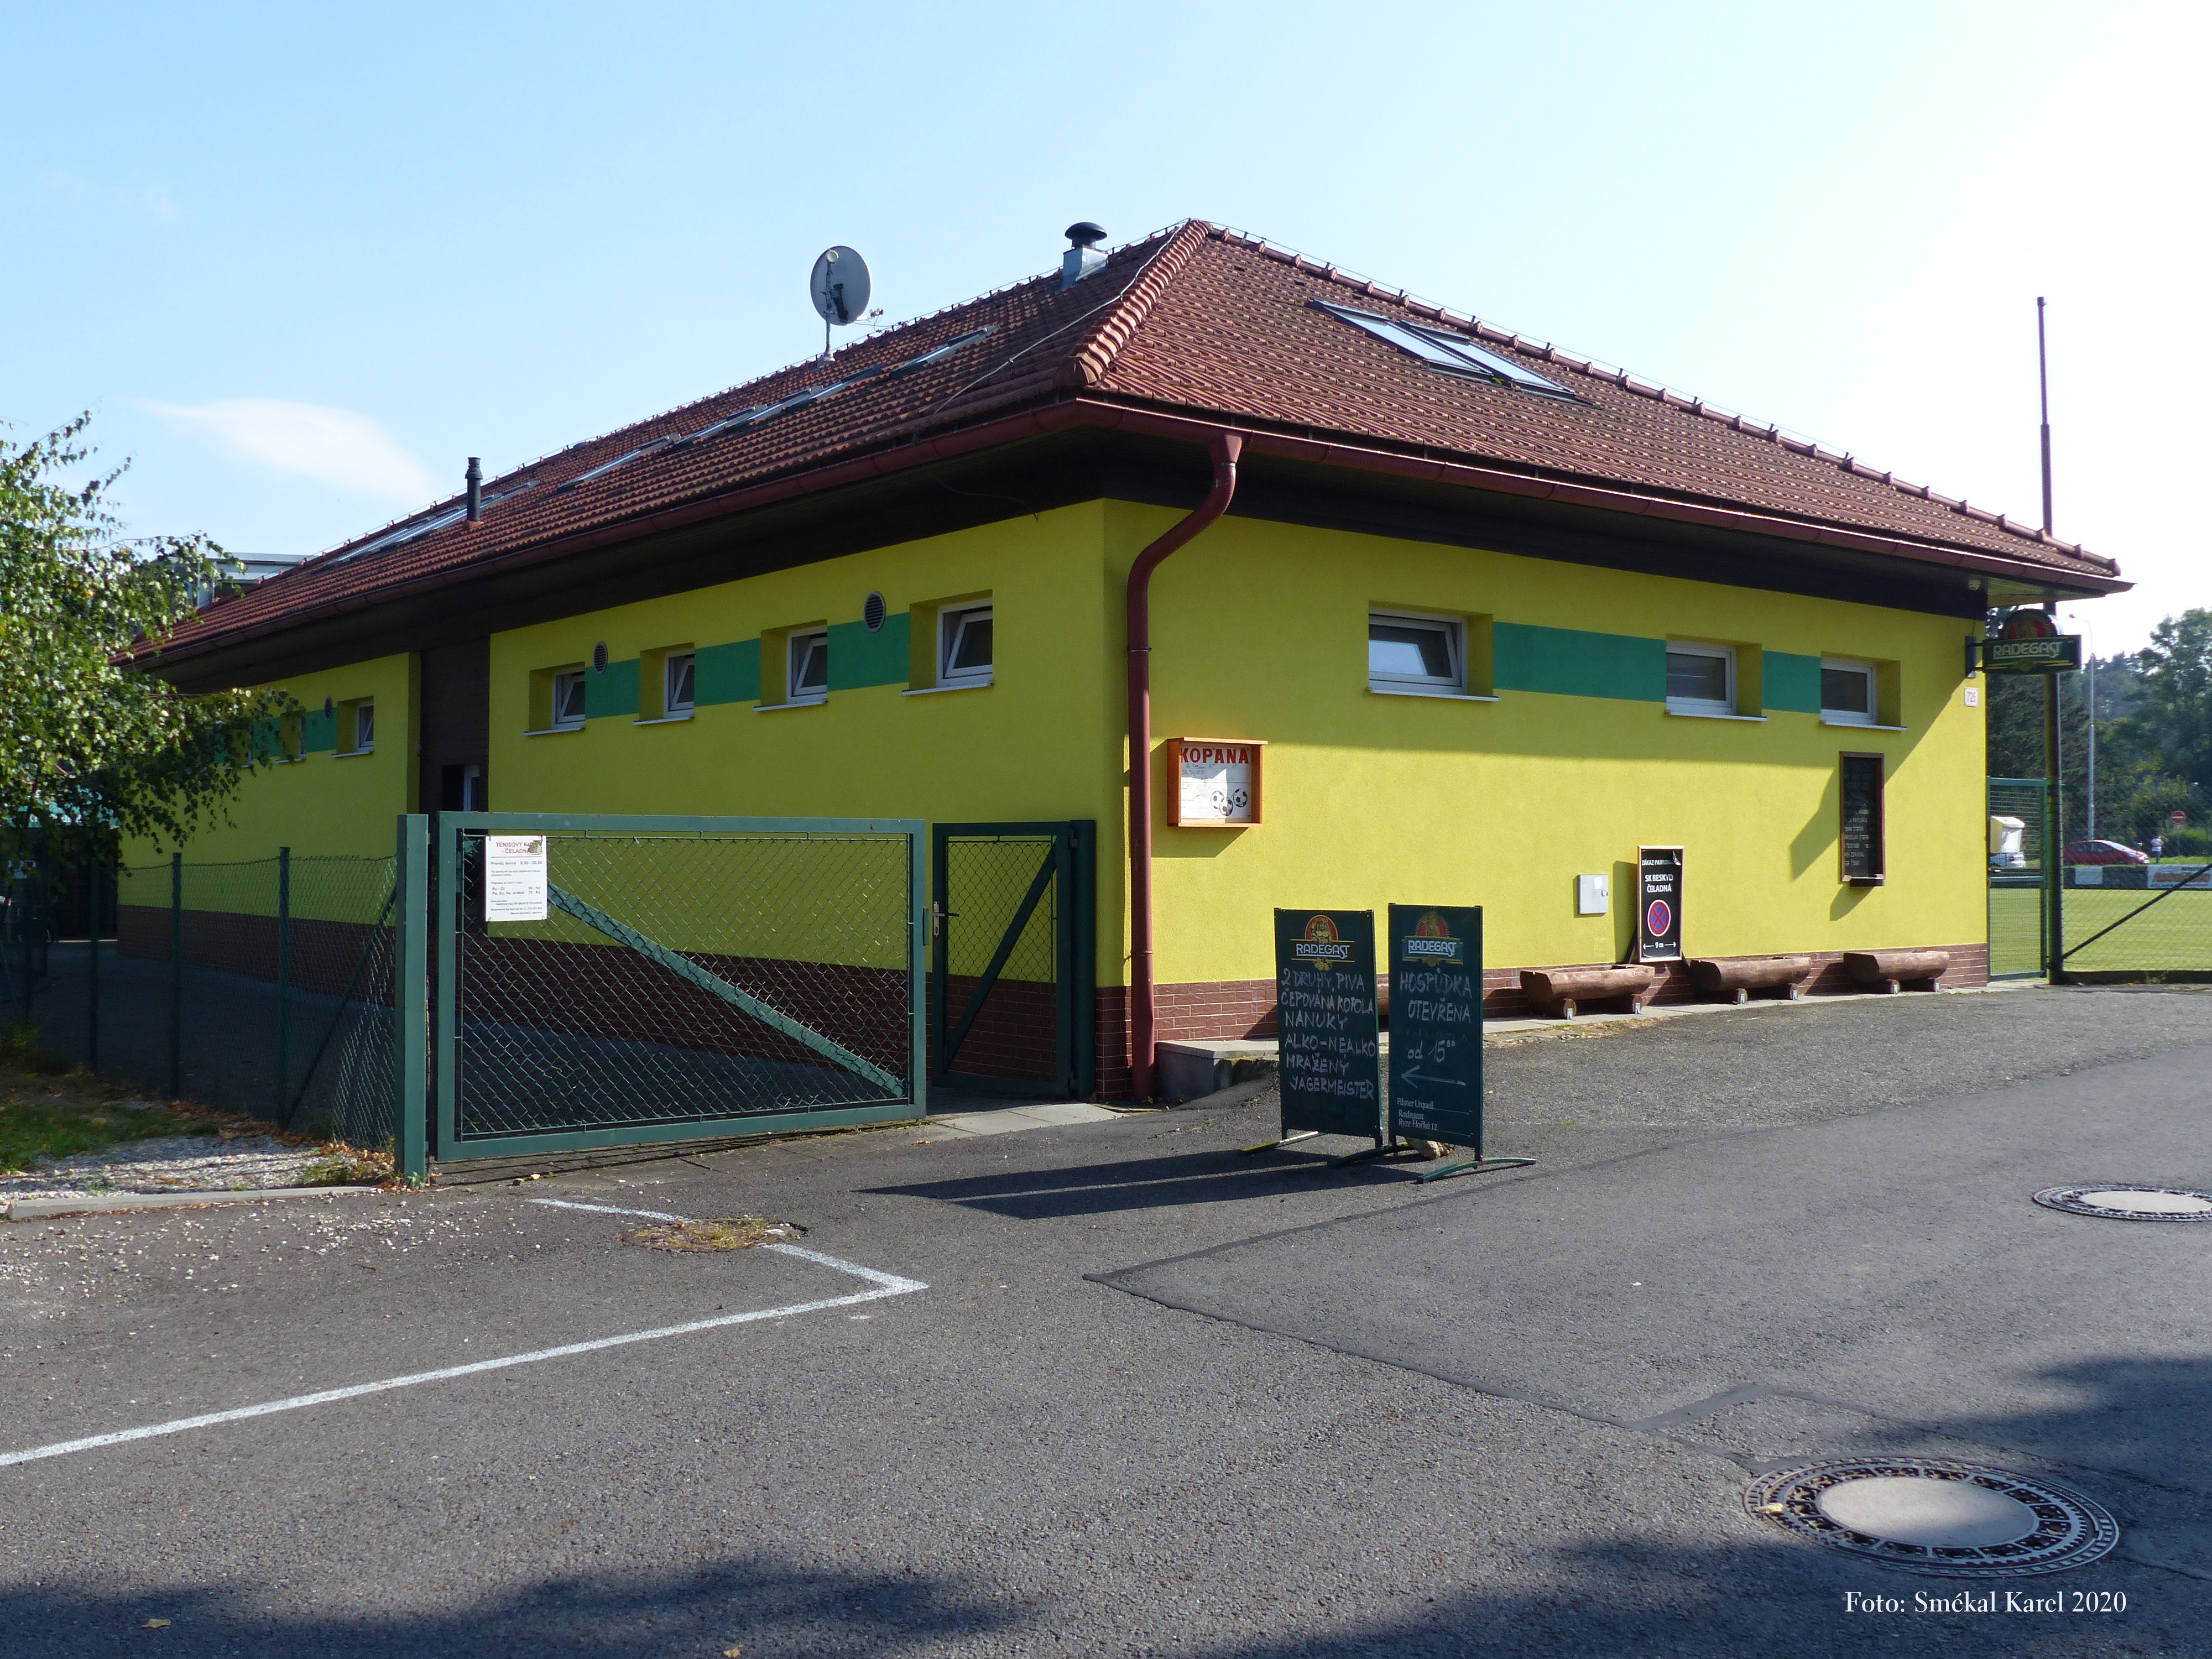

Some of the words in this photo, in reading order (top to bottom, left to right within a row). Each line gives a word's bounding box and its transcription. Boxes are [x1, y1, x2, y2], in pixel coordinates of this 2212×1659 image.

[1993, 642, 2063, 660] RADEGAST
[1646, 883, 1672, 893] ČELADNÁ
[1296, 943, 1350, 959] RADEGAST
[1408, 940, 1457, 957] RADEGAST
[1281, 968, 1291, 986] 2
[1293, 971, 1332, 988] DRUHY
[1335, 972, 1365, 992] PIVA
[1400, 968, 1472, 999] HOSPŮDKA
[1408, 997, 1471, 1024] OTEVŘENA
[1285, 1010, 1348, 1030] NANUKY
[1407, 1039, 1423, 1060] od
[1397, 1097, 1414, 1107] Pilsner
[1415, 1099, 1434, 1110] Urquell
[1399, 1109, 1425, 1120] Radegast
[1412, 1119, 1430, 1130] Hořká
[1431, 1123, 1438, 1131] 12
